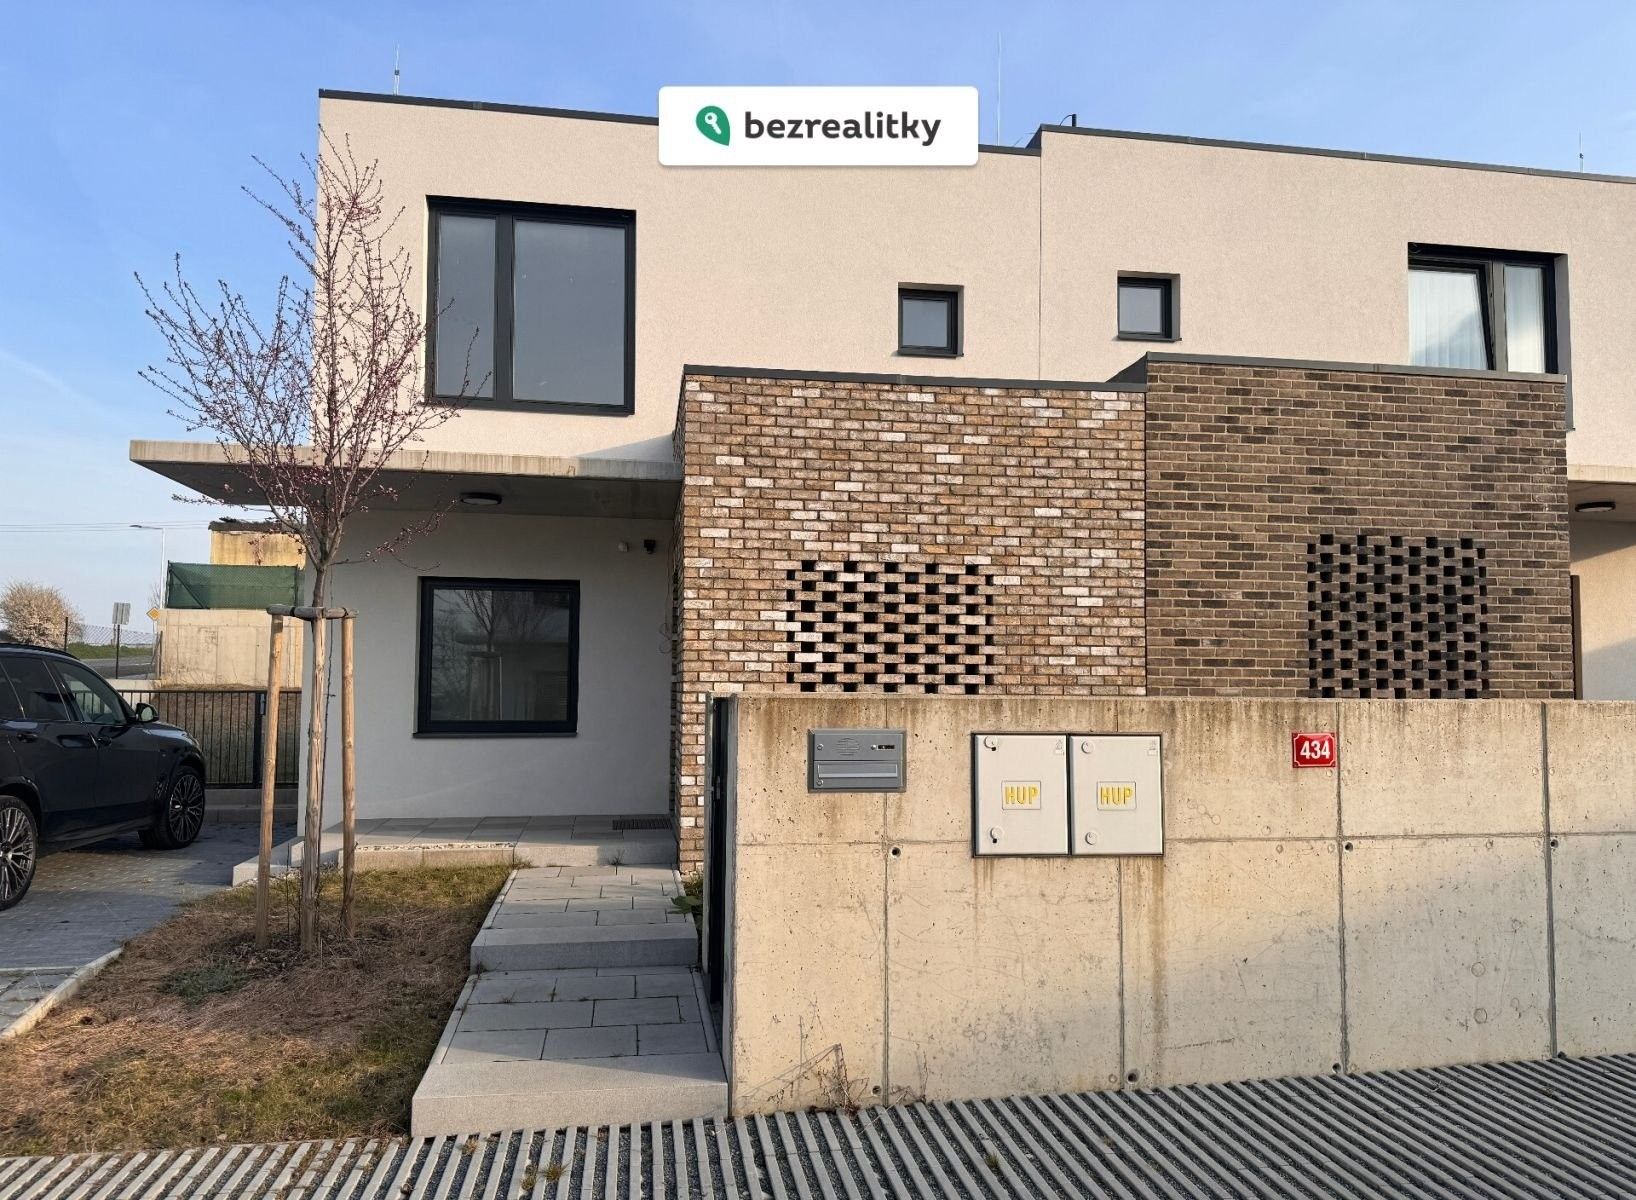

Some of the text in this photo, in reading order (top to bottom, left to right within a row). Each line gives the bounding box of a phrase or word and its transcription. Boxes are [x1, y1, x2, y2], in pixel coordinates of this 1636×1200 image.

[1300, 740, 1330, 759] 434
[1005, 785, 1039, 805] HUP
[1100, 785, 1133, 805] HUP
